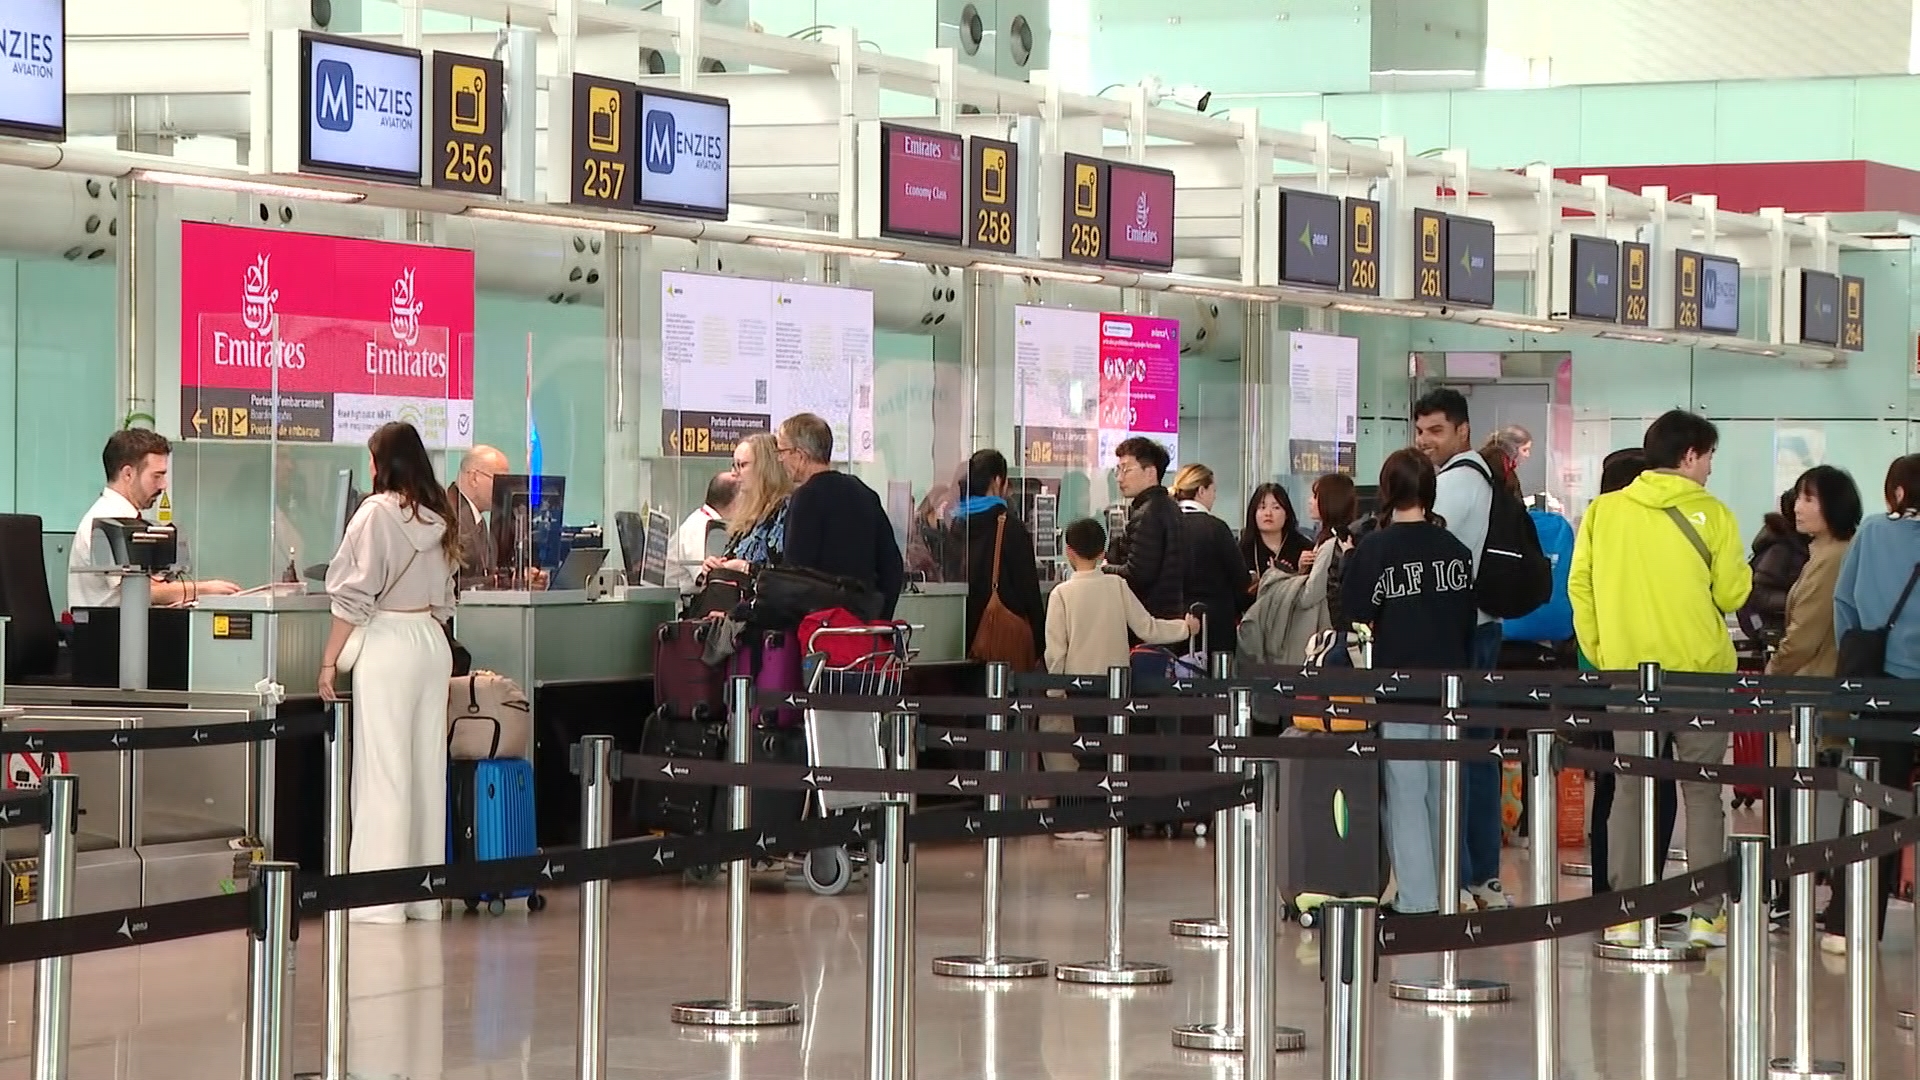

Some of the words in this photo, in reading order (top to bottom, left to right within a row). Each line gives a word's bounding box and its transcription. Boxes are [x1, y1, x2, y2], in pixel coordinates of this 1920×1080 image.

[12, 62, 54, 79] AVIATION
[320, 71, 413, 122] MENZIES
[380, 118, 413, 130] AVIATION
[650, 121, 722, 166] MENZIES
[904, 136, 942, 158] Emirates
[445, 140, 493, 184] 256
[583, 158, 625, 200] 257
[905, 182, 931, 200] Economy
[932, 184, 947, 201] Class
[978, 209, 1011, 245] 258
[1071, 223, 1100, 257] 259
[1127, 224, 1158, 244] Emirates
[1312, 233, 1328, 246] aena
[1352, 258, 1376, 289] 260
[1421, 268, 1441, 297] 261
[1626, 294, 1646, 321] 262
[1679, 302, 1697, 327] 263
[214, 331, 305, 369] Emirates
[366, 341, 446, 378] Emirates
[1432, 559, 1474, 592] IG
[674, 767, 689, 775] aena
